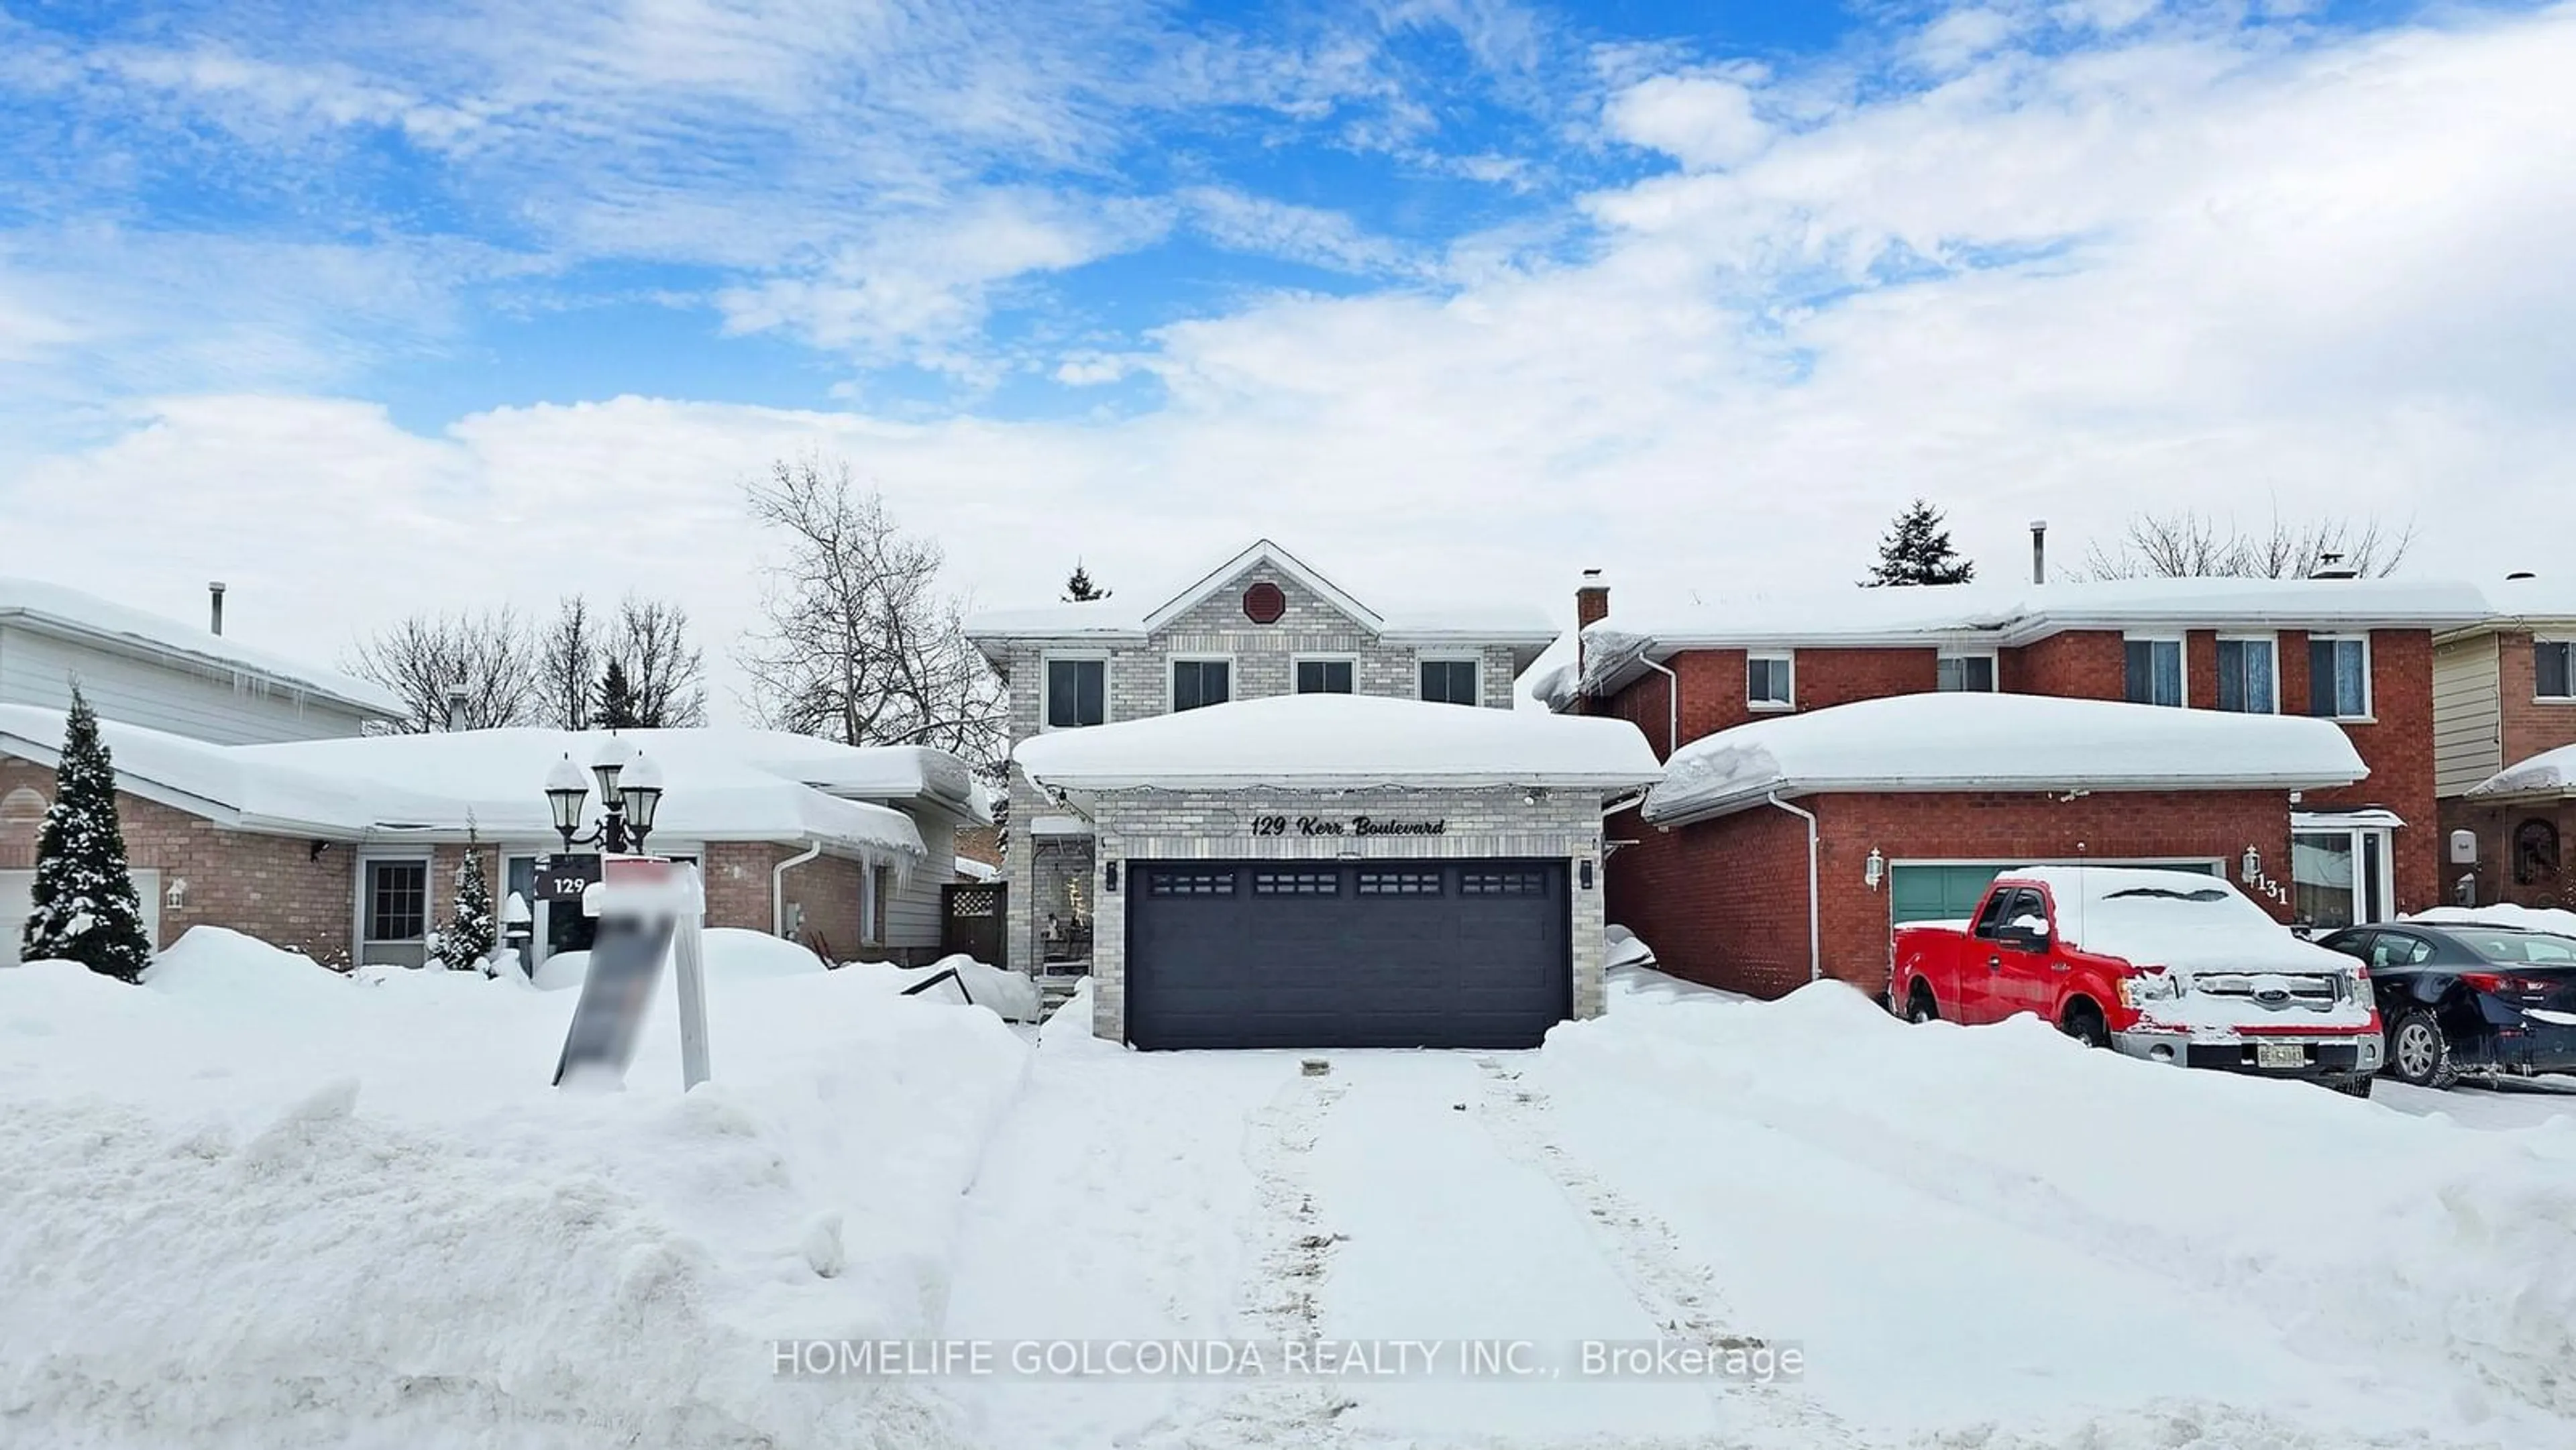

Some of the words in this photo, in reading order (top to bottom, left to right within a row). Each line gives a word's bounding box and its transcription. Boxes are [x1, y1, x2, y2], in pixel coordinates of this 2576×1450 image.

[1251, 816, 1286, 836] 129
[1296, 816, 1344, 836] Kerr
[1352, 816, 1447, 836] Boulevard
[553, 878, 585, 894] 129
[2258, 873, 2288, 905] 131
